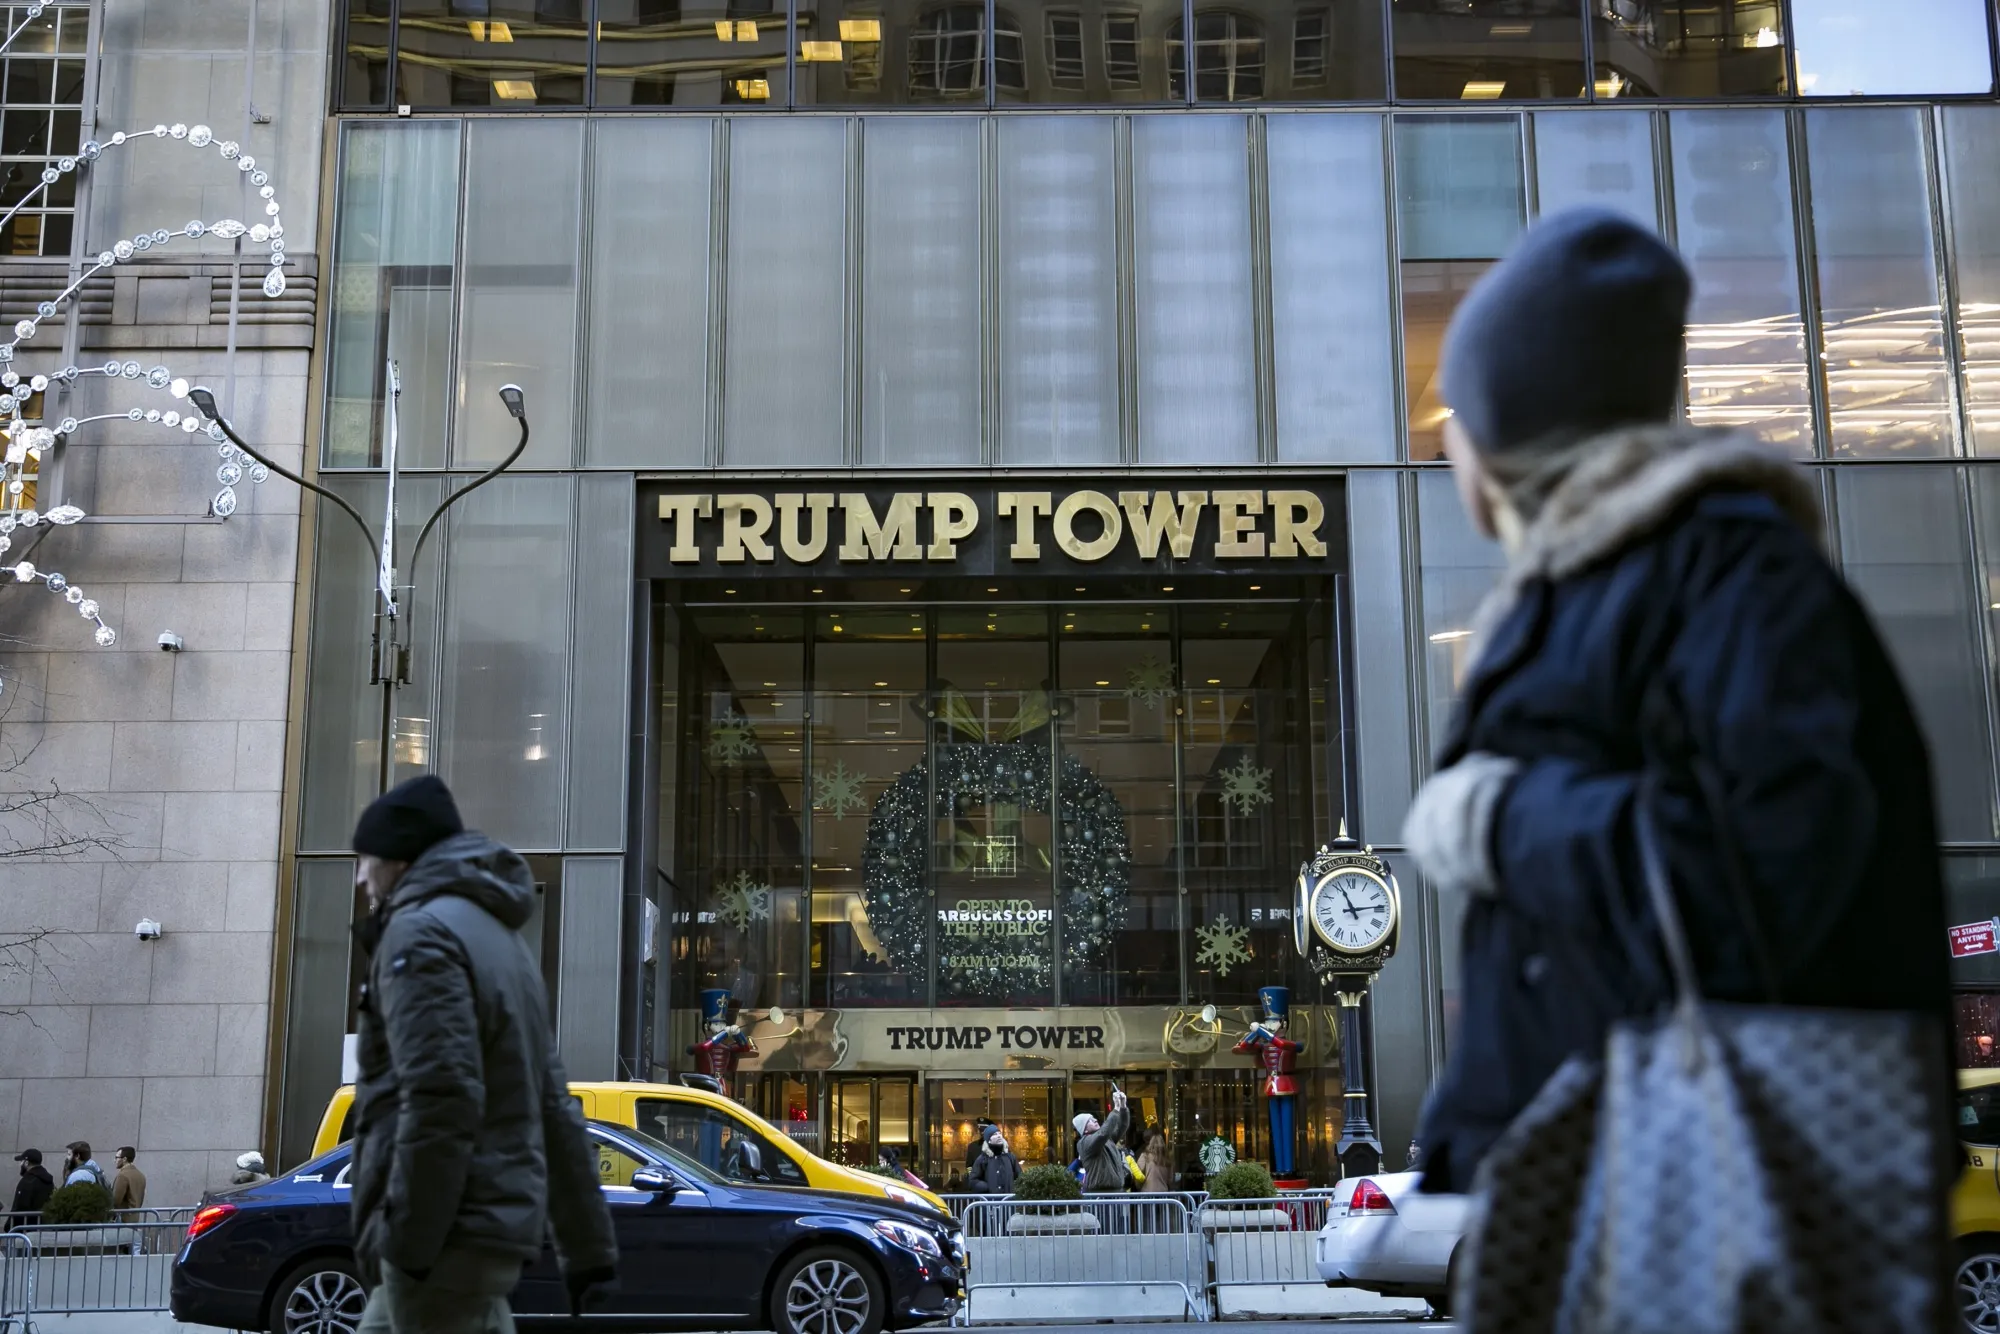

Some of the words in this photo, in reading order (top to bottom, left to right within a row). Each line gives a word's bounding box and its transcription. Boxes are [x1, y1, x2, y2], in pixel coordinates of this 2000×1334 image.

[659, 490, 979, 563] TRUMP
[997, 489, 1328, 561] TOWER
[1323, 858, 1349, 870] TRUMP
[1351, 857, 1378, 870] TOWER
[956, 899, 1004, 914] OPEN
[1007, 899, 1033, 914] TO
[943, 921, 979, 936] THE
[982, 921, 1047, 936] PUBLIC
[1961, 924, 1991, 936] STANDING
[1957, 933, 1988, 944] ANYTIME
[986, 955, 999, 967] to
[1001, 955, 1016, 968] 10
[1018, 955, 1041, 968] PM
[886, 1026, 992, 1050] TRUMP
[996, 1025, 1105, 1049] TOWER
